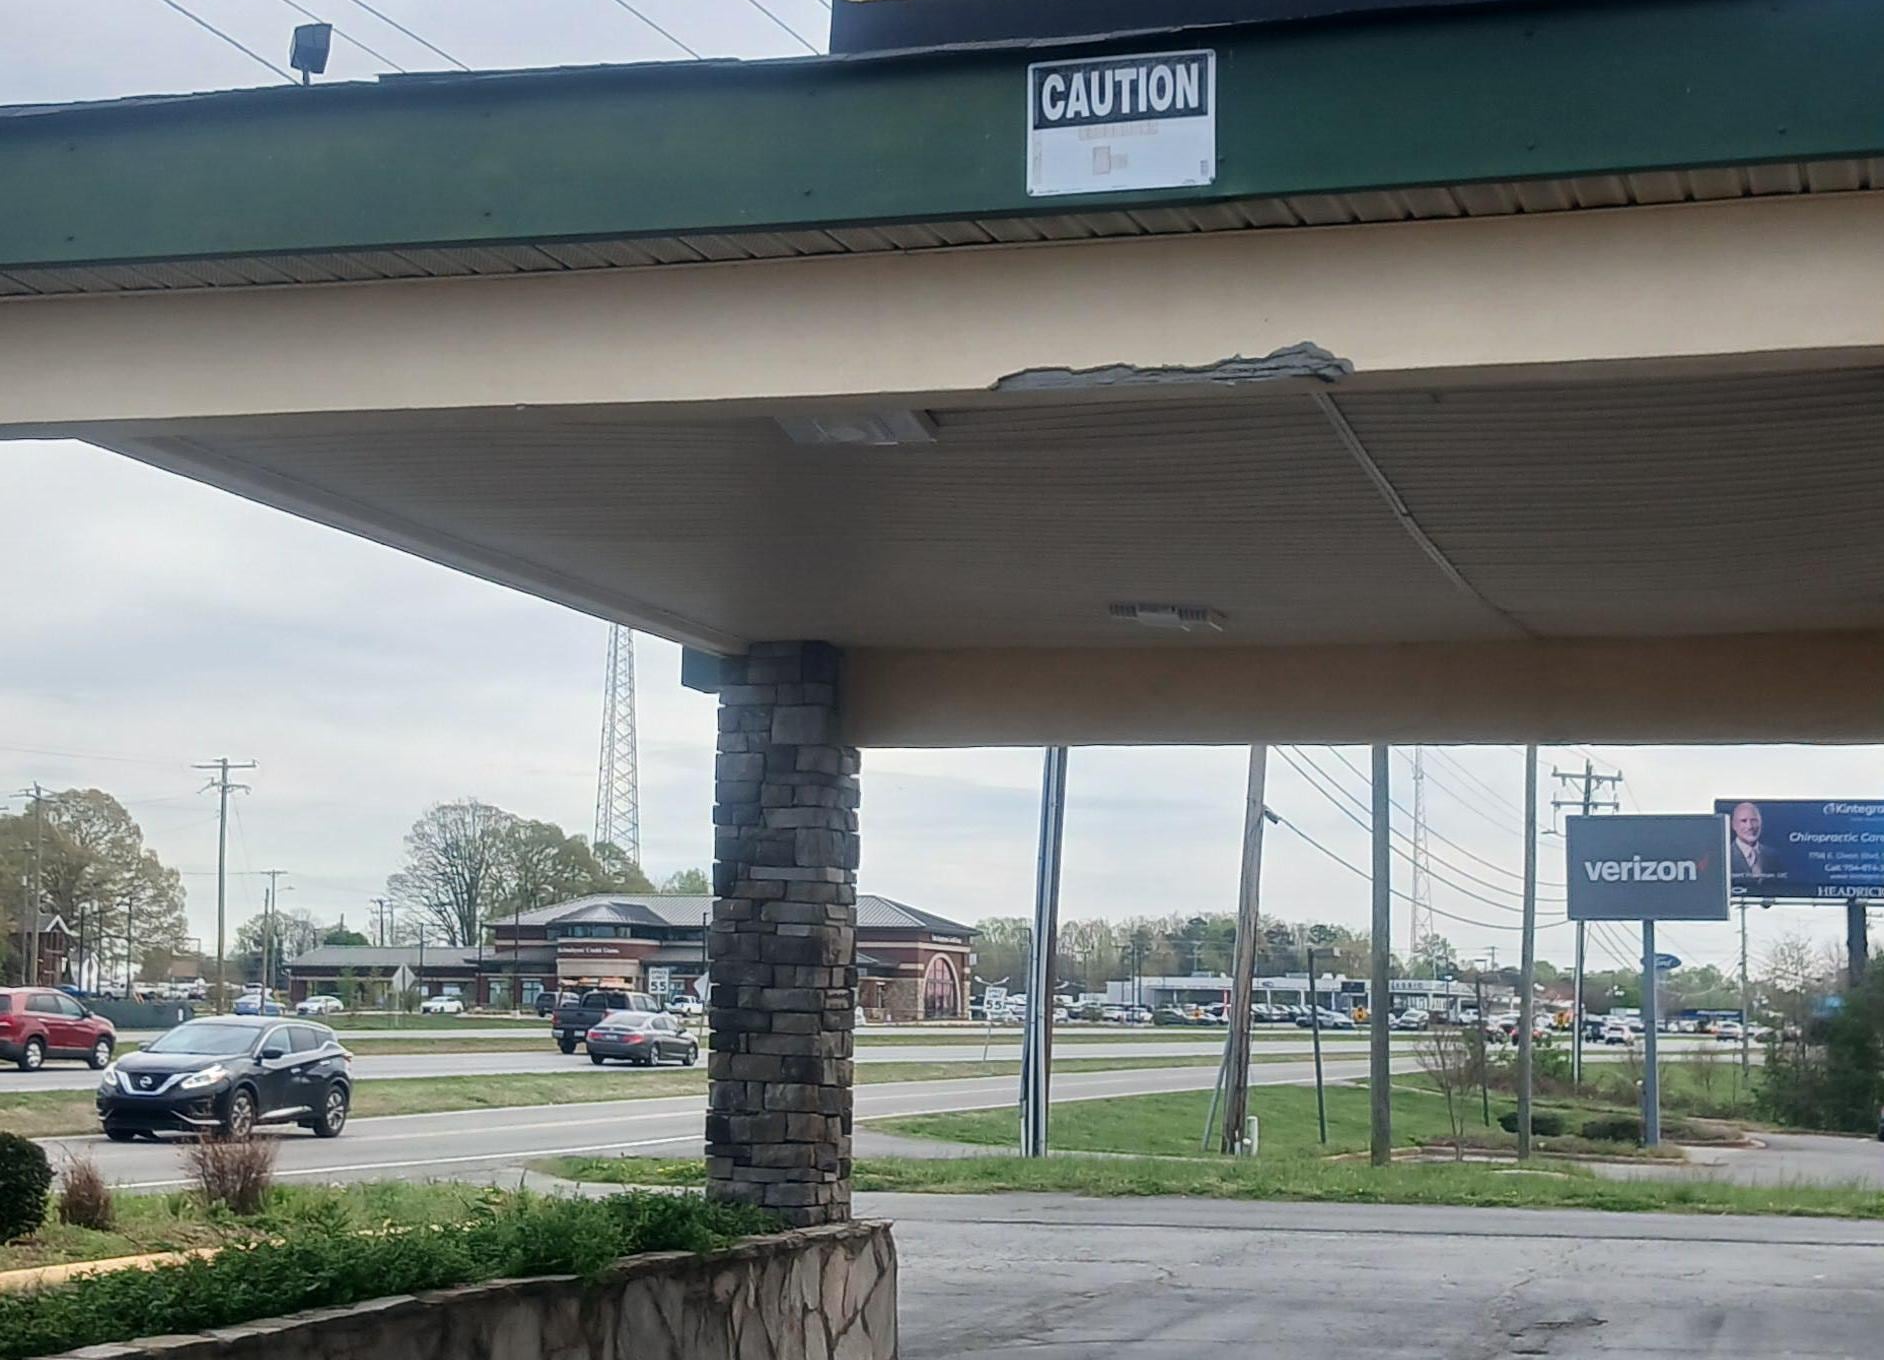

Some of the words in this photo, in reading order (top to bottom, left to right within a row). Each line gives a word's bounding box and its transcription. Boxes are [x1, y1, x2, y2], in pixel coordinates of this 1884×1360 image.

[1041, 62, 1200, 122] CAUTION
[1789, 832, 1858, 844] Chiropractic
[1584, 854, 1697, 882] verizon
[651, 981, 667, 992] 55
[986, 999, 1002, 1010] 55
